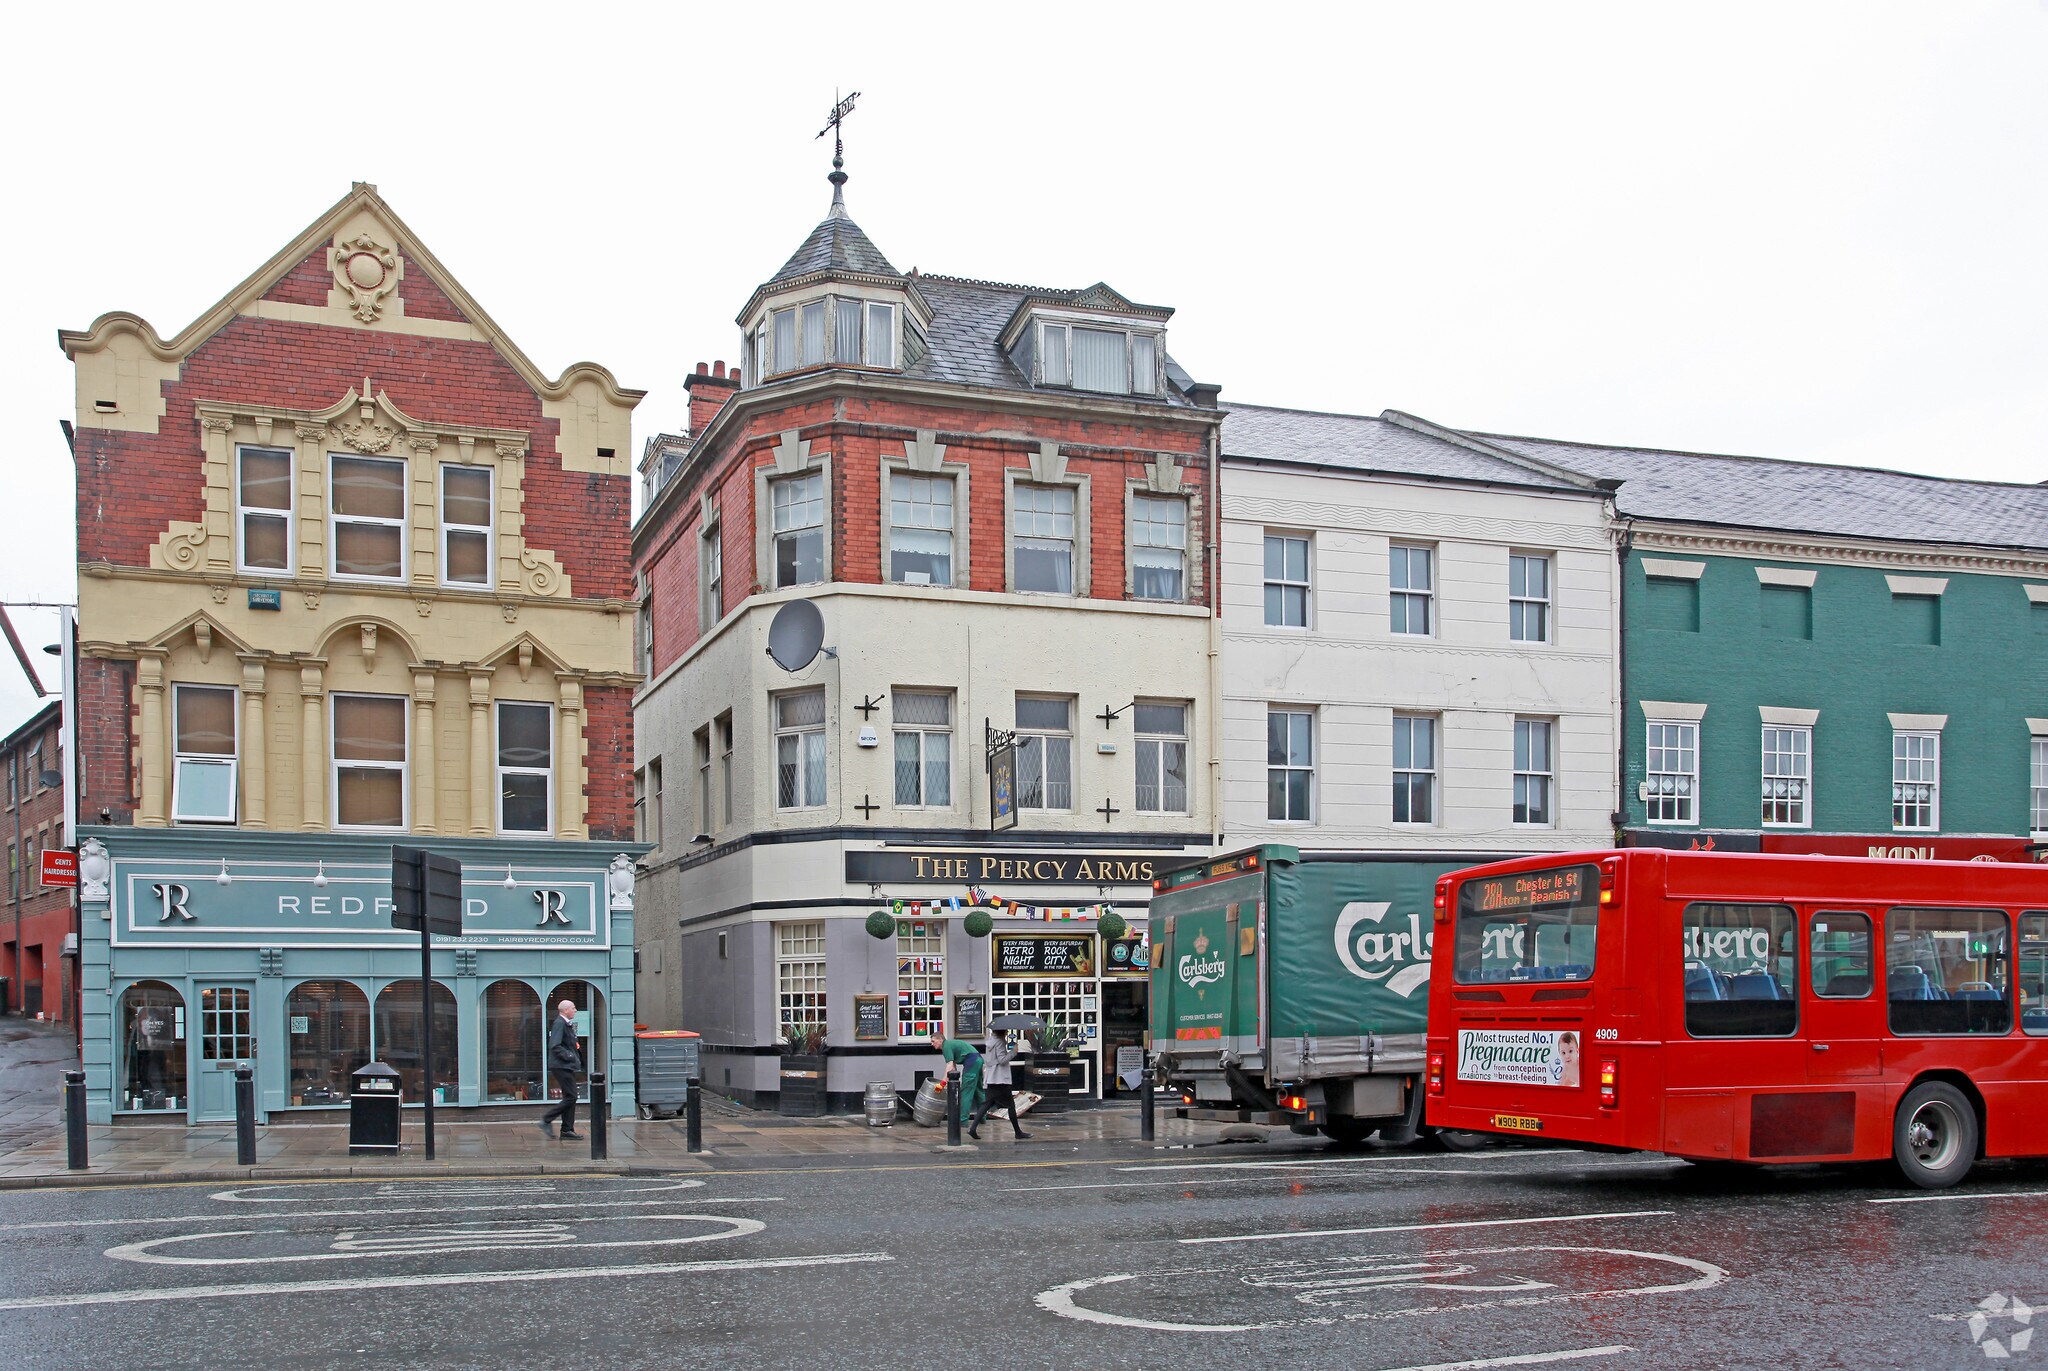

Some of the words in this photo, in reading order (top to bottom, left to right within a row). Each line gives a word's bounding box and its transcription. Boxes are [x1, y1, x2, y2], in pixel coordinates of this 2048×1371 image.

[55, 858, 72, 866] GENTS
[911, 856, 969, 878] THE
[980, 857, 1067, 879] PERCY
[1074, 858, 1153, 881] ARMS
[1483, 882, 1503, 910] 28A
[1515, 877, 1551, 893] Chester
[1554, 874, 1563, 888] le
[1566, 872, 1578, 887] St
[1530, 889, 1570, 904] Beamish
[151, 883, 198, 922] R
[278, 895, 489, 917] REDFD
[533, 889, 572, 926] R
[1003, 946, 1035, 955] RETRO
[1044, 946, 1068, 955] ROCK
[1003, 955, 1034, 965] NIGHT
[1044, 955, 1067, 965] CITY
[1179, 954, 1226, 988] Carlsberg
[1475, 1032, 1497, 1043] Most
[1498, 1032, 1530, 1044] trusted
[1532, 1032, 1554, 1044] No.1
[1595, 1028, 1618, 1040] 4909
[1460, 1031, 1551, 1071] Pregnacare
[1507, 1064, 1547, 1073] conception
[1458, 1072, 1491, 1081] VITABIOTICS
[1498, 1073, 1547, 1084] breast-feeding
[1498, 1116, 1517, 1128] W909
[1520, 1118, 1536, 1129] RBB
